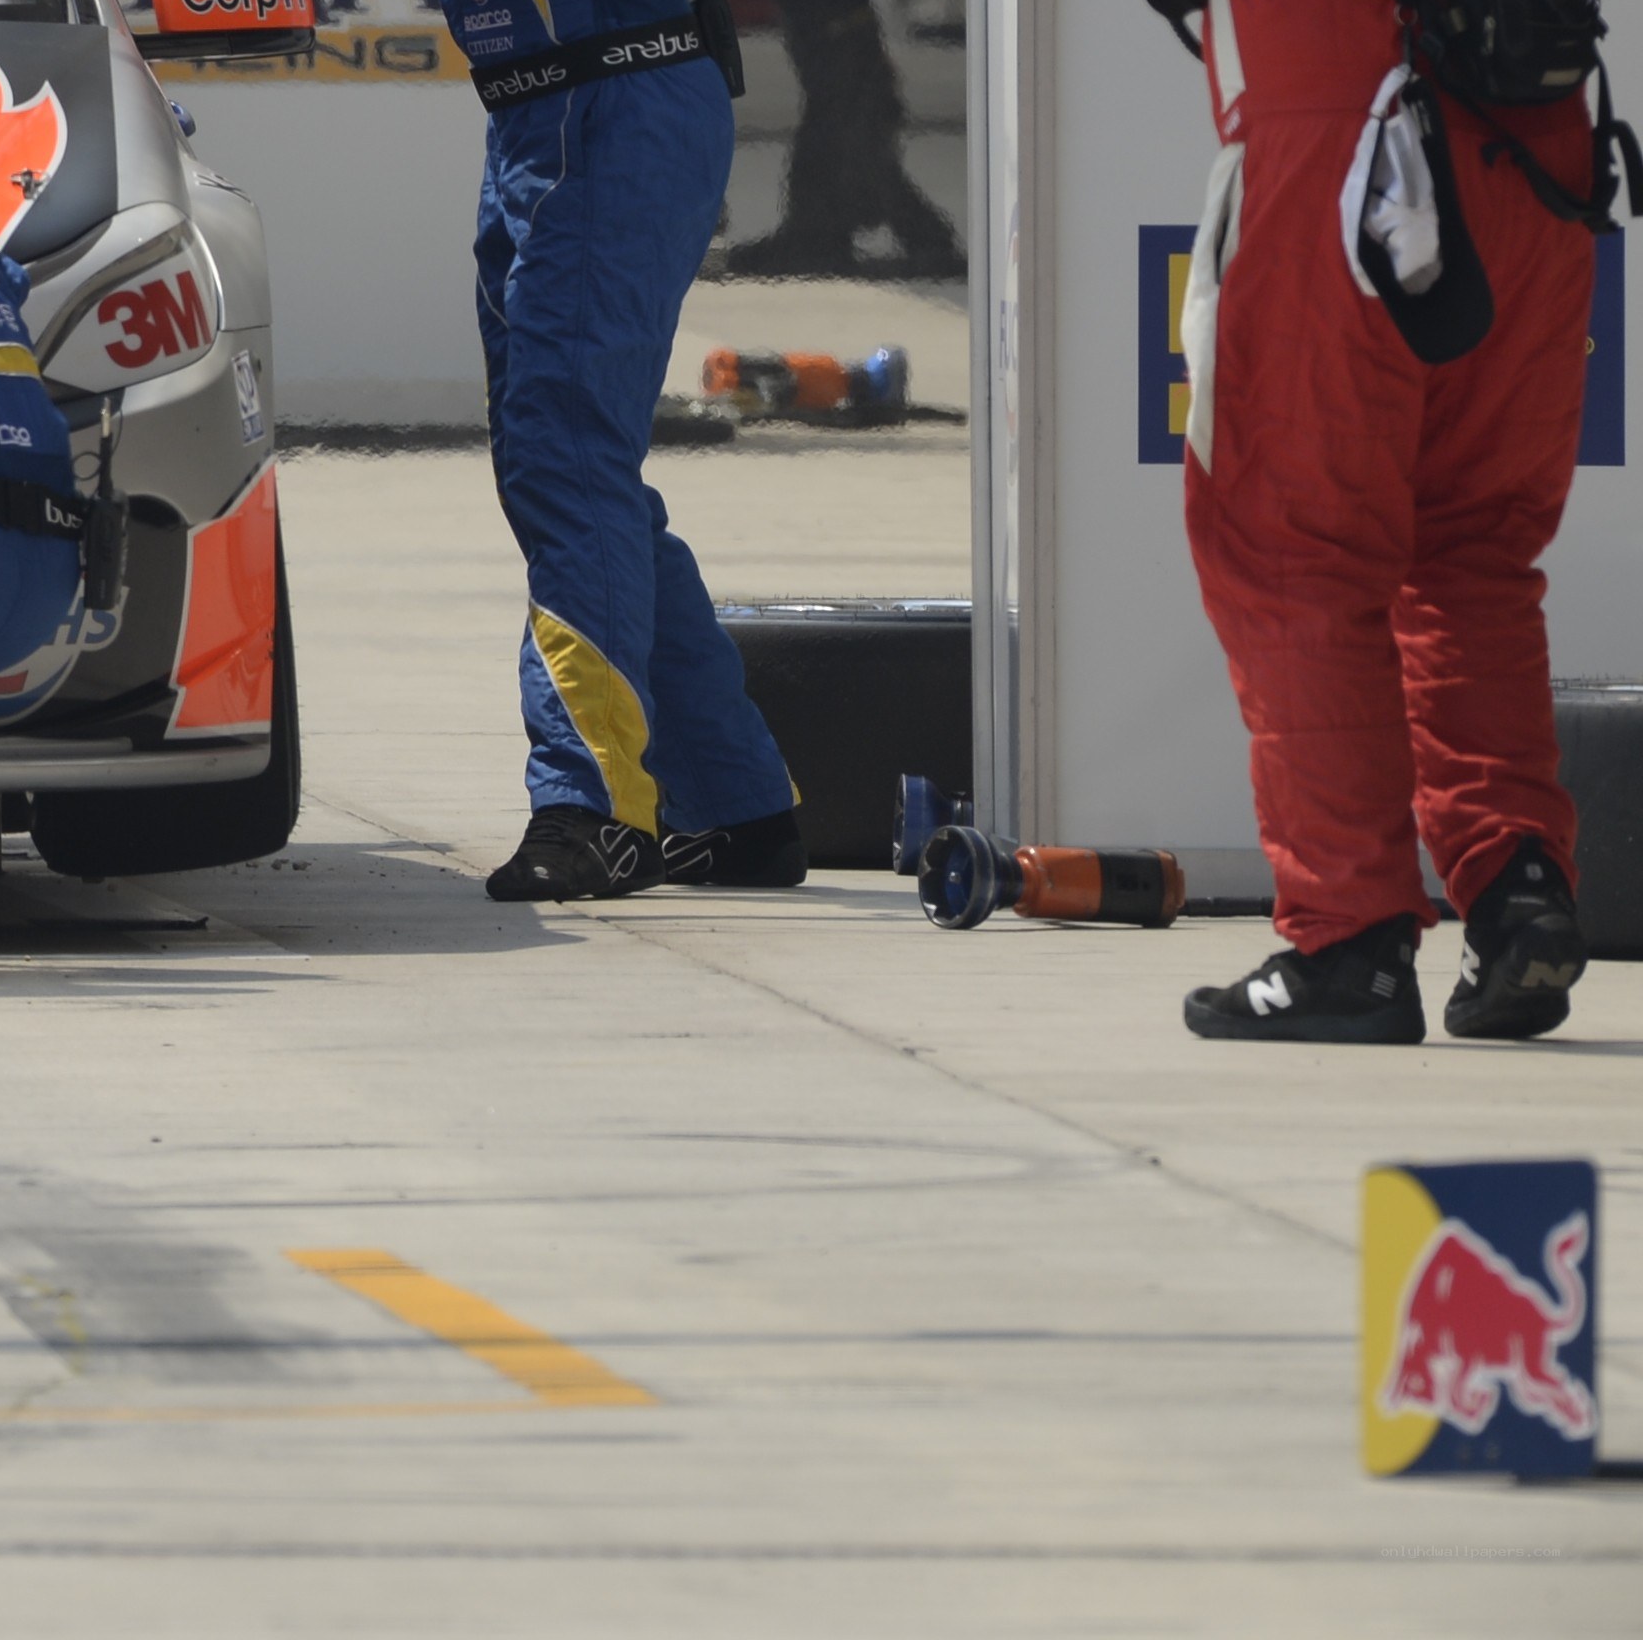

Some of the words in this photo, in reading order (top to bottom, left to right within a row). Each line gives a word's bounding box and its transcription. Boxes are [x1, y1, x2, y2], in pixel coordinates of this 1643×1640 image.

[466, 35, 514, 57] CITIZEN
[602, 32, 700, 66] erebus
[483, 63, 567, 100] erebus
[97, 270, 213, 370] 3M
